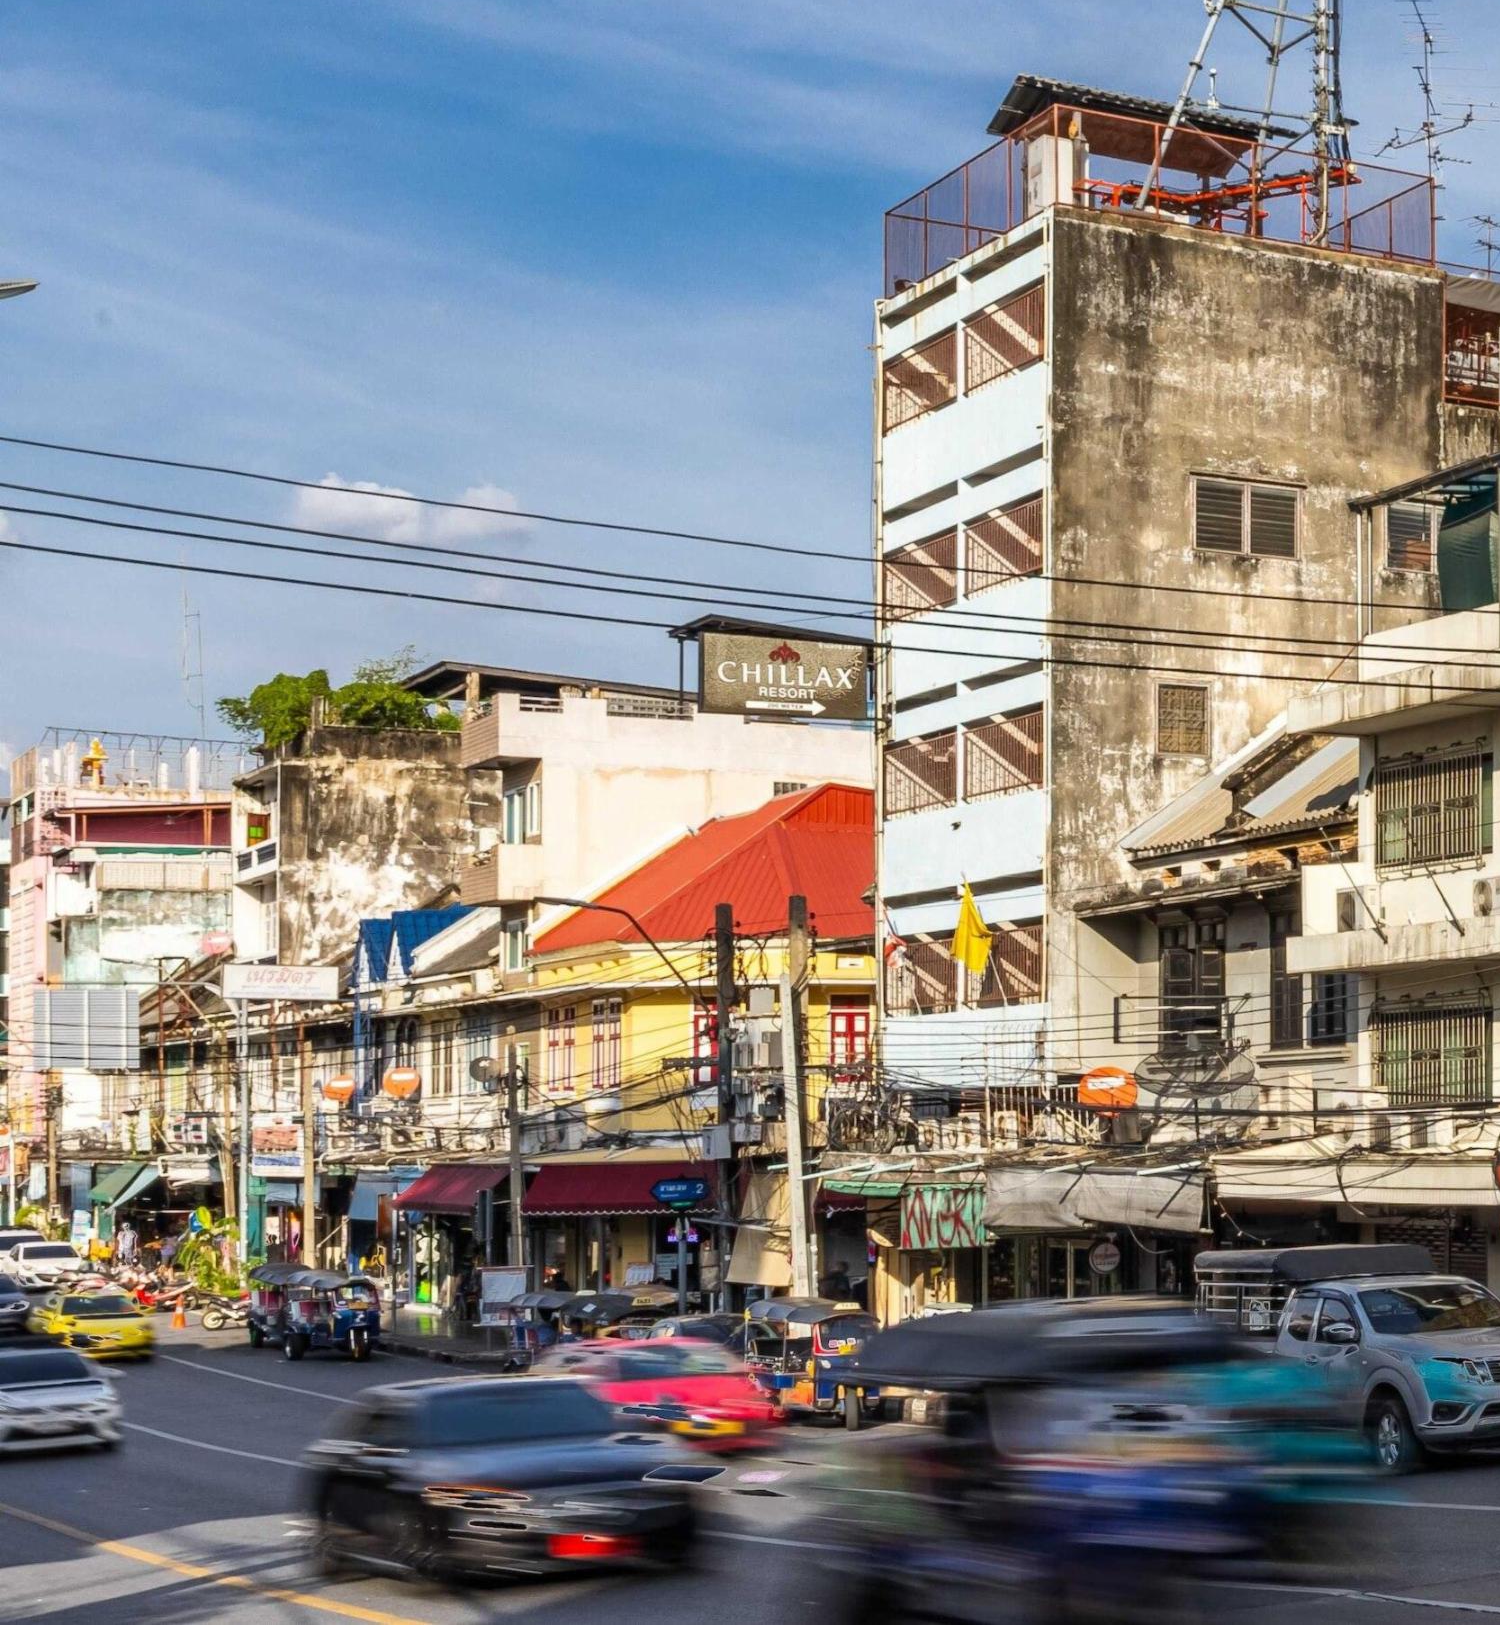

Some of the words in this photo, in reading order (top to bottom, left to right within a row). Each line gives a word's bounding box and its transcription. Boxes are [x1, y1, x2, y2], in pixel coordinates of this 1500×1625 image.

[717, 660, 853, 690] CHILLAX
[758, 686, 816, 699] RESORT
[696, 1183, 704, 1194] 2
